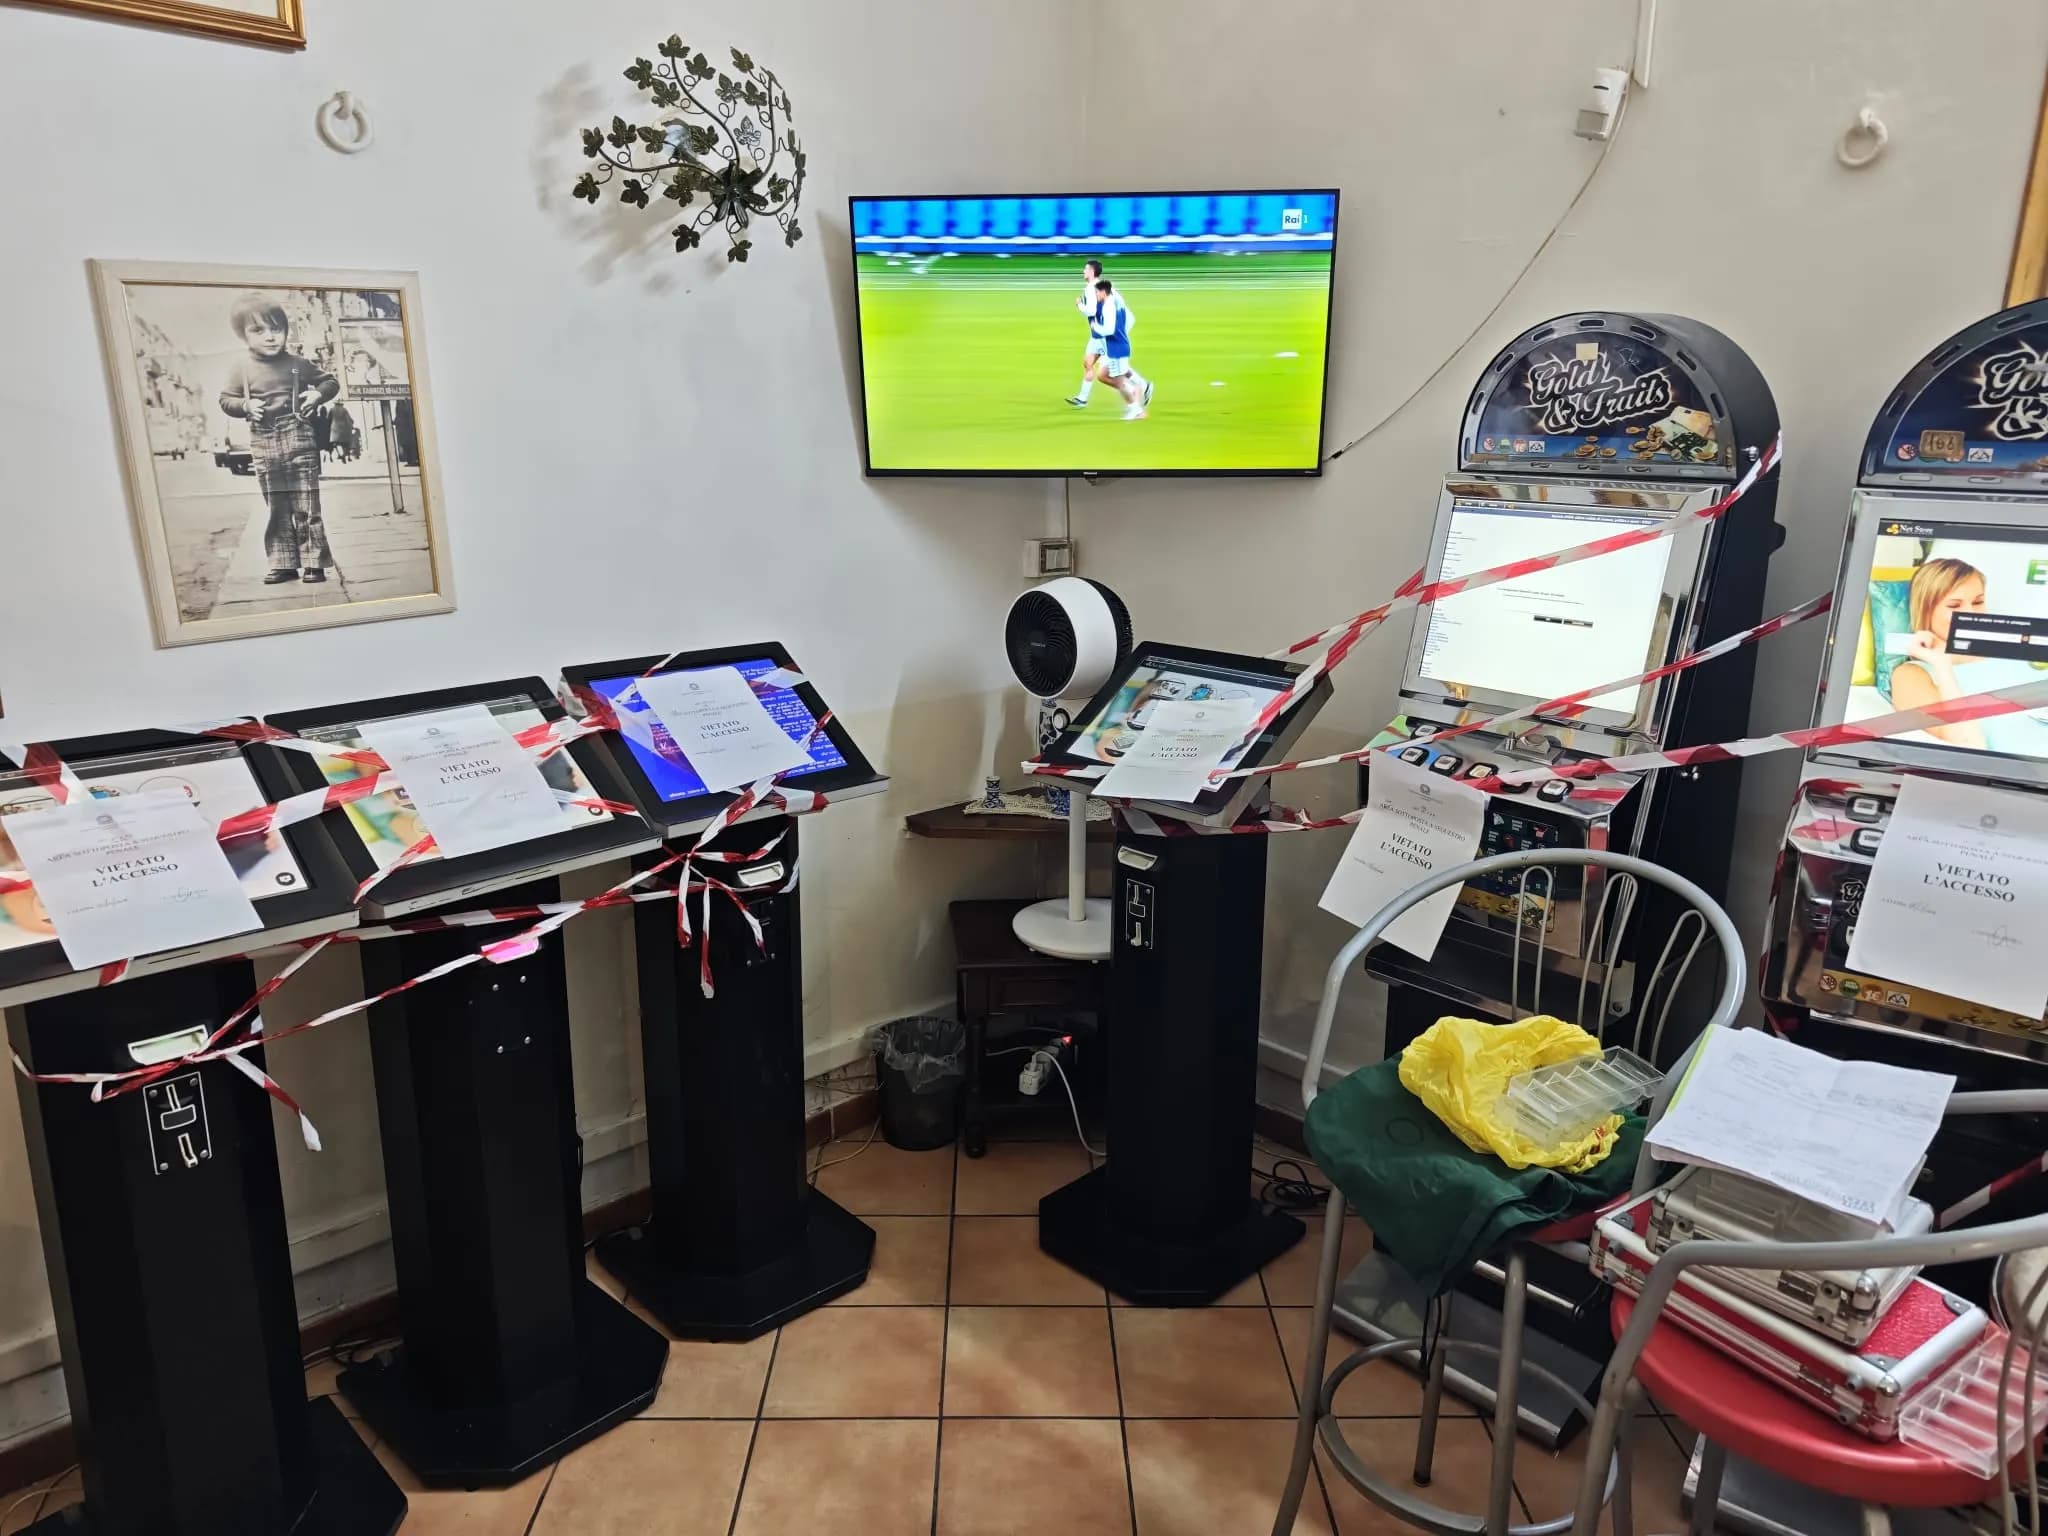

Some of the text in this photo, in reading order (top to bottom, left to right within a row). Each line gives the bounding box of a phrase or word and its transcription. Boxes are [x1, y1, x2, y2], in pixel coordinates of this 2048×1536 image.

[1284, 214, 1301, 224] Rai
[1533, 357, 1604, 400] Gold
[1548, 378, 1666, 428] & Fruits
[700, 719, 741, 732] VIETATO
[700, 726, 751, 740] L'ACCESSO
[440, 759, 491, 774] VIETATO
[440, 766, 502, 785] L'ACCESSO
[1380, 841, 1433, 870] L'ACCESSO
[1392, 832, 1432, 857] VIETATO
[91, 863, 179, 888] L'ACCESSO
[95, 854, 166, 876] VIETATO
[1937, 862, 2011, 887] VIETATO
[1923, 874, 2016, 903] L'ACCESSO
